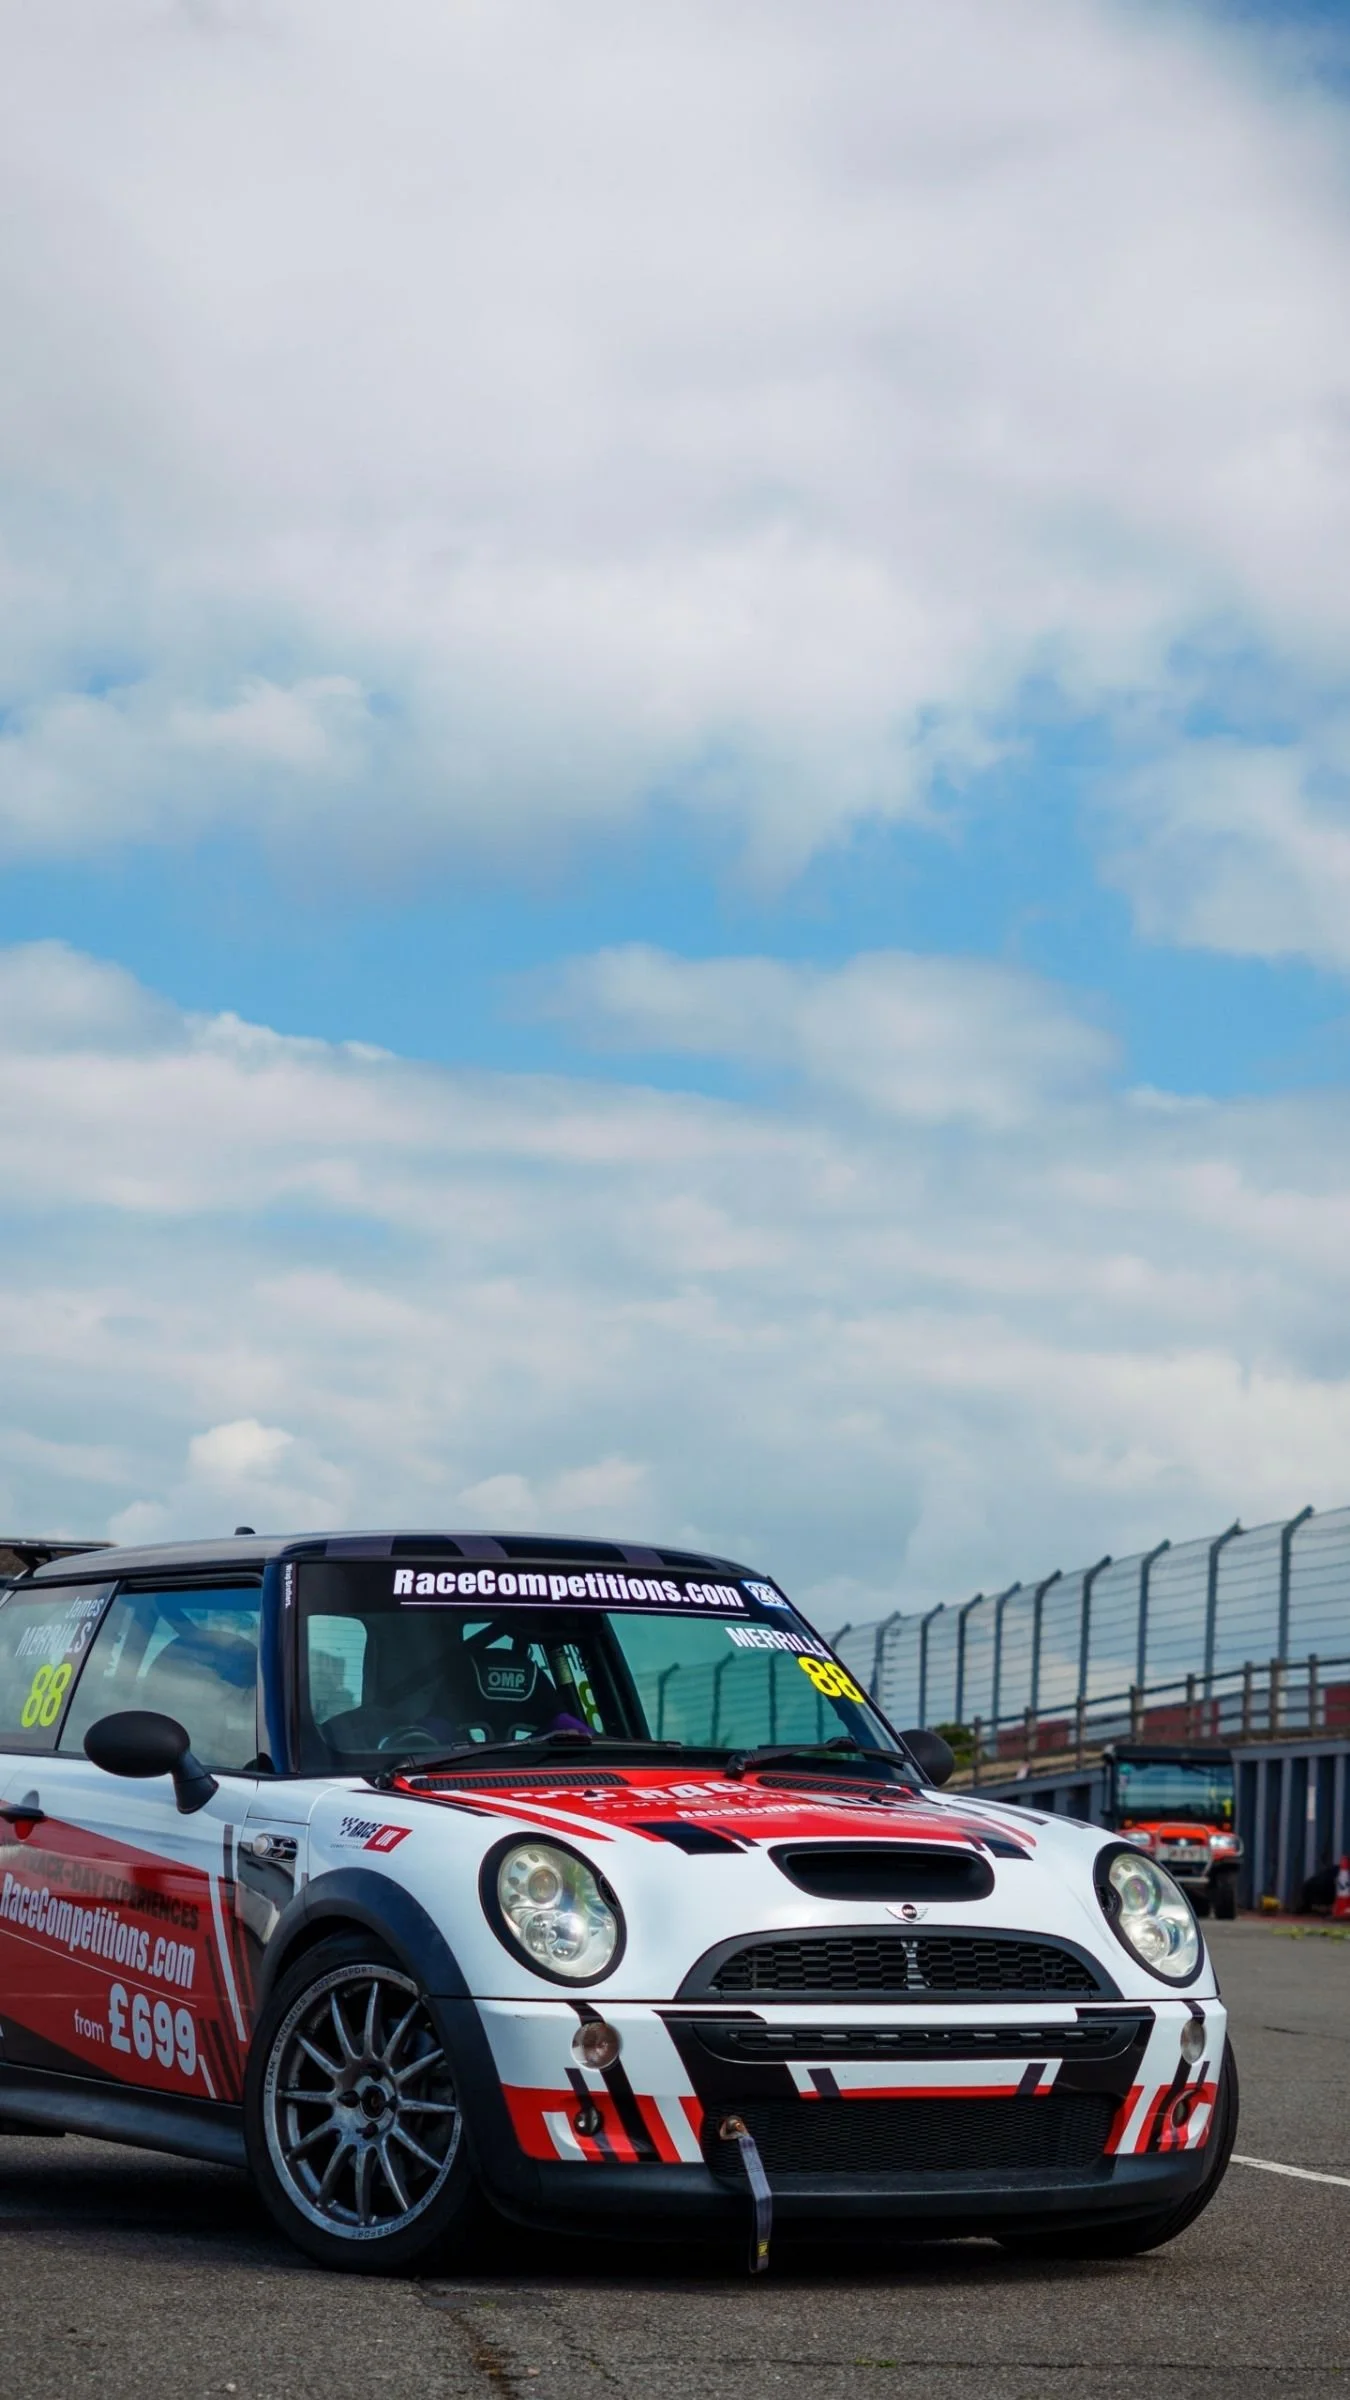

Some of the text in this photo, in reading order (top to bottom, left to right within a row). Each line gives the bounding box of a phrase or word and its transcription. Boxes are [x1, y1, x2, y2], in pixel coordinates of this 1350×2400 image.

[65, 1595, 105, 1619] James
[393, 1568, 746, 1608] RaceCompetitions.com
[14, 1621, 93, 1657] MERRILLS
[724, 1626, 833, 1661] MERRILLS
[20, 1662, 73, 1728] 88
[487, 1671, 526, 1688] OMP
[797, 1656, 866, 1704] 88
[627, 1781, 748, 1800] RAC
[347, 1820, 383, 1840] RACE
[375, 1829, 401, 1847] UK
[103, 1874, 199, 1931] EXPERIENCES
[0, 1872, 196, 1989] RaceCompetitions.com
[74, 1982, 197, 2076] from £699
[264, 1965, 375, 2096] TEAM DYNAMICS MOTORSPORT
